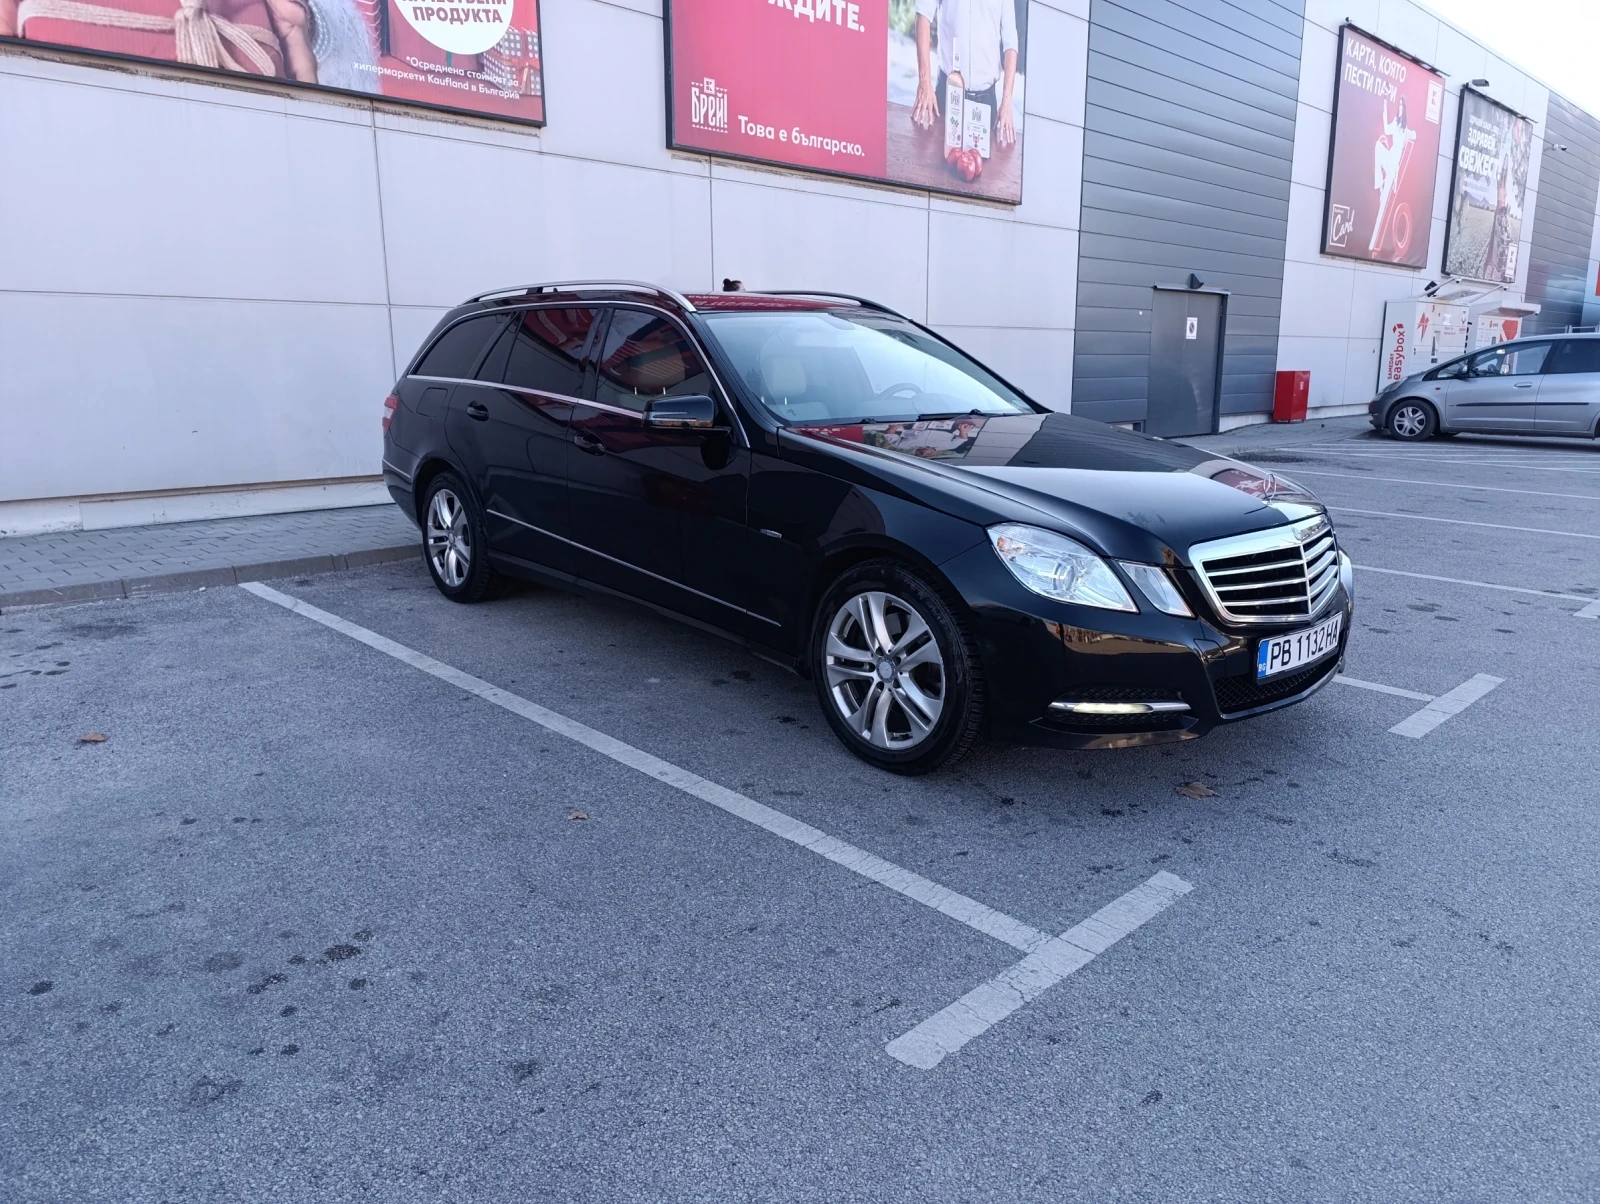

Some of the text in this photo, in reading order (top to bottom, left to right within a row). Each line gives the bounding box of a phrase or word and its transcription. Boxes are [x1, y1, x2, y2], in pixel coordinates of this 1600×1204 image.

[412, 6, 503, 25] ПРОДУКТА
[466, 70, 507, 85] стойност
[507, 79, 519, 87] за
[1344, 62, 1374, 93] ПЕСТИ
[1346, 38, 1407, 83] КАРТА, КОЯТО
[354, 61, 426, 82] хипермаркети
[428, 75, 469, 91] Kaufland
[478, 84, 520, 100] България
[737, 114, 865, 157] Това е българско.
[1333, 209, 1355, 242] Card
[1387, 353, 1395, 380] SAMEDAY
[1393, 330, 1406, 381] easybox
[1269, 639, 1292, 670] PB
[1297, 629, 1324, 661] 1132
